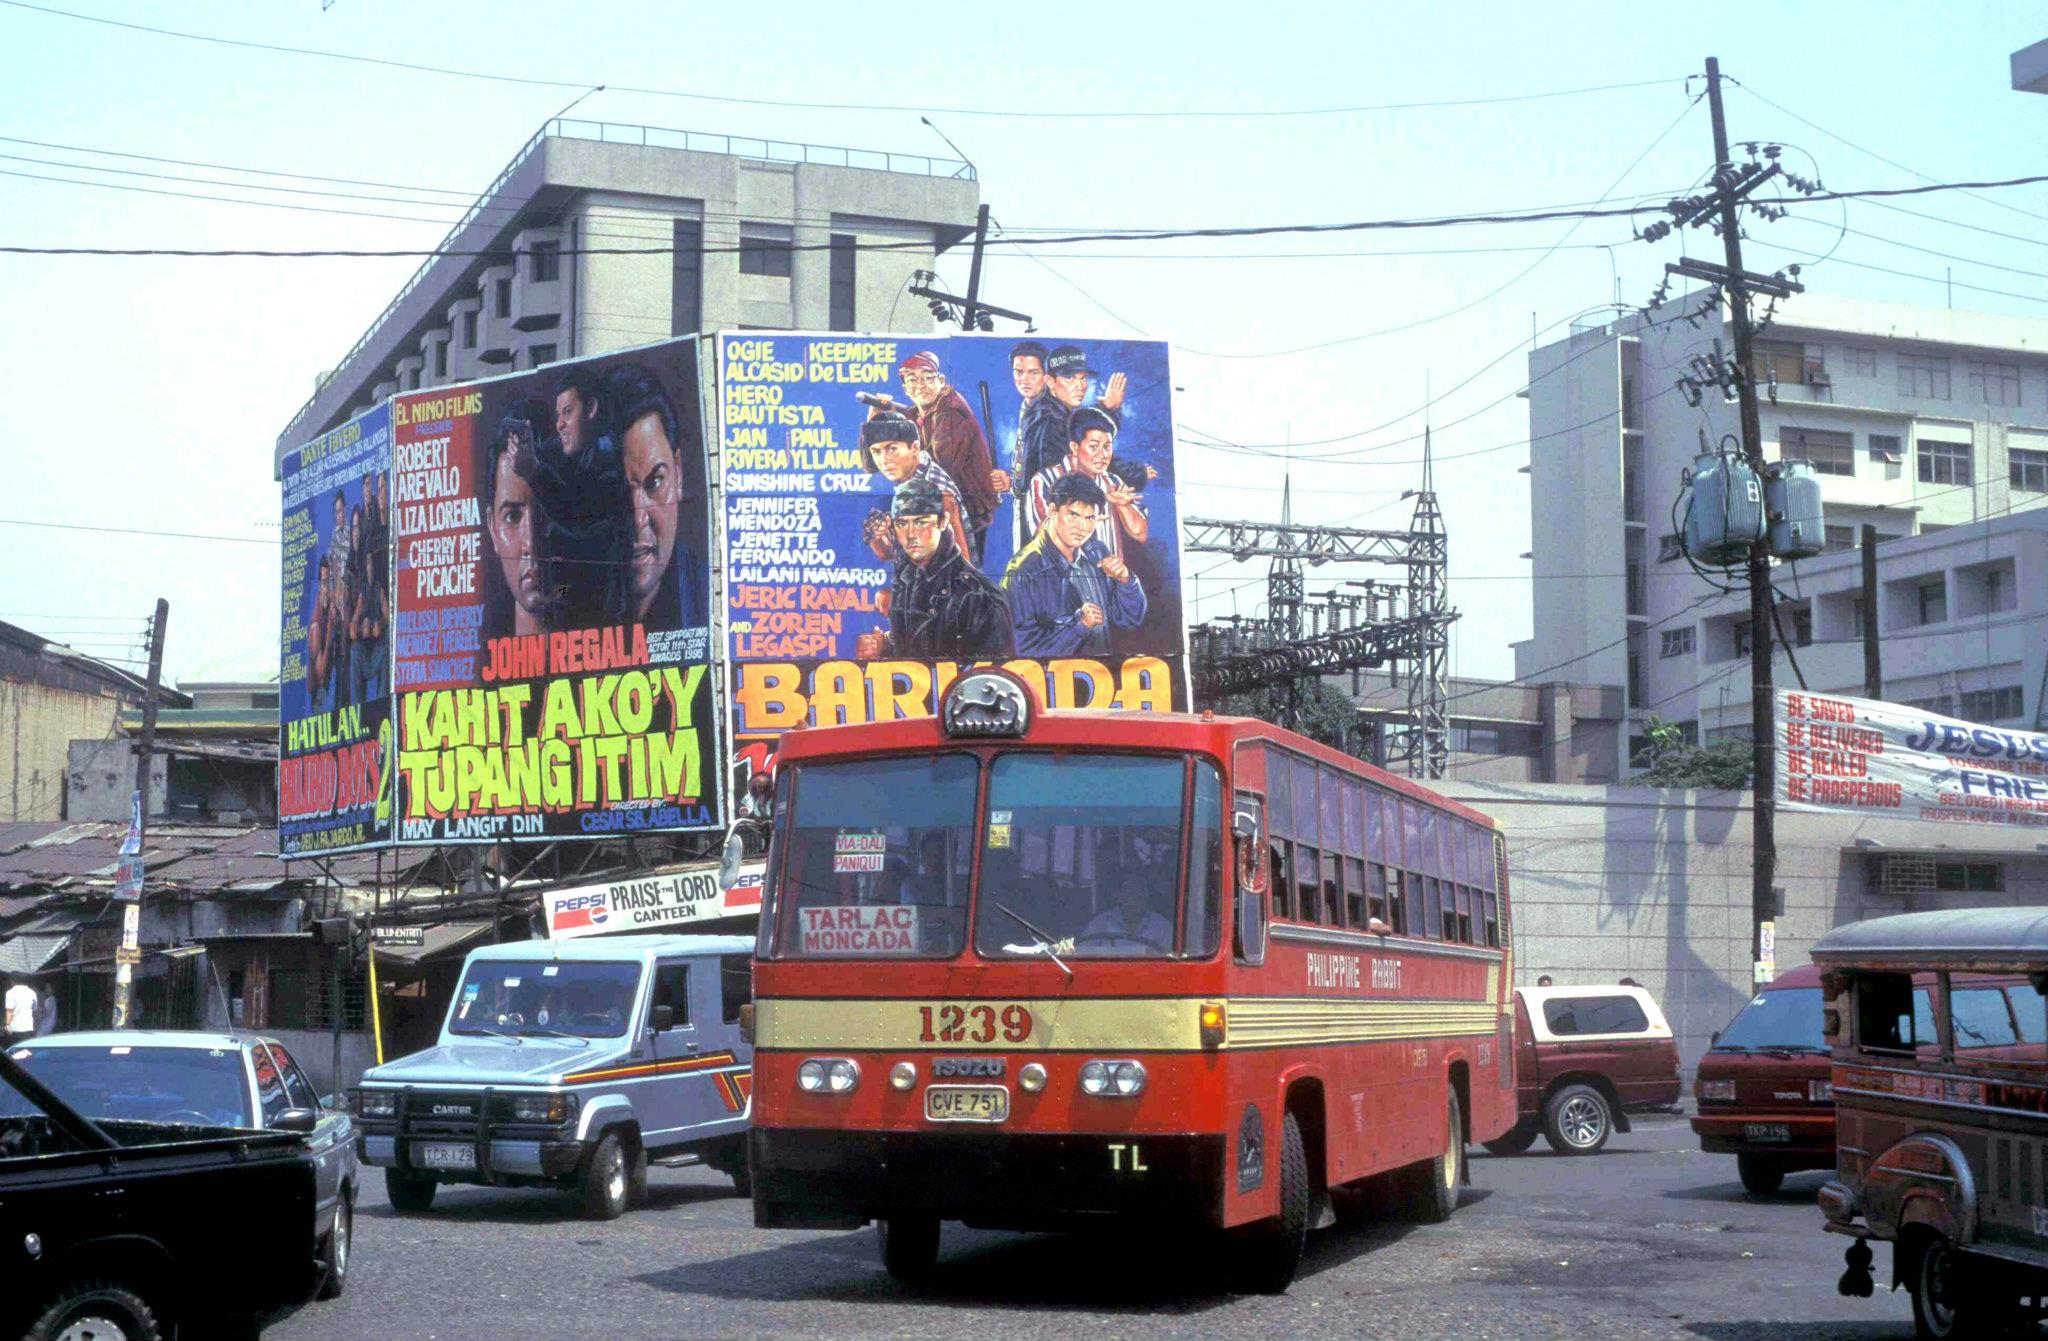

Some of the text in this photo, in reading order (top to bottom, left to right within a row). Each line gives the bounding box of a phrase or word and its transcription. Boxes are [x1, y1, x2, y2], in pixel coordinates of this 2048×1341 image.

[726, 341, 775, 362] OGIE
[809, 342, 898, 364] KEEMPEE
[726, 362, 804, 383] ALCASID
[810, 364, 889, 384] De LEON
[726, 384, 783, 406] HERO
[396, 392, 482, 426] EL NINO FILMS
[726, 404, 826, 426] BAUTISTA
[726, 428, 768, 448] JAN
[790, 428, 838, 448] PAUL
[396, 437, 450, 473] ROBERT
[726, 449, 788, 470] RIVERA
[790, 449, 863, 470] YLLANA
[398, 466, 460, 502] AREVALO
[726, 473, 873, 492] SUNSHINE CRUZ
[398, 497, 481, 536] LIZA LORENA
[728, 497, 819, 514] JENNIFER
[729, 514, 822, 532] MENDOZA
[410, 532, 481, 568] CHERRY PIE
[731, 532, 818, 550] JENETTE
[730, 549, 836, 566] FERNANDO
[417, 563, 476, 598] PICACHE
[730, 566, 887, 587] LAILANI NAVARRO
[730, 584, 875, 612] JERIC RAVAL
[730, 612, 842, 634] AND ZOREN
[646, 632, 664, 644] BEST
[648, 641, 670, 653] ACTOR
[687, 637, 706, 650] STAR
[736, 634, 837, 658] LEGASPI
[482, 623, 650, 682] JOHN REGALA
[650, 650, 682, 663] AWARDS
[404, 665, 708, 751] KAHIT AKO'Y
[1787, 694, 1855, 724] BE SAVED
[1787, 722, 1884, 754] BE DELIVERED
[375, 718, 392, 829] 2
[400, 738, 572, 817] TUPANG
[582, 728, 701, 803] ITIM
[1788, 749, 1867, 778] BE HEALED
[1788, 777, 1902, 808] BE PROSPEROUS
[610, 800, 651, 810] DIRECTED
[402, 814, 544, 839] MAY LANGIT DIN
[581, 812, 625, 832] CESAR
[648, 805, 712, 828] ABELLA
[834, 856, 881, 871] PANIQUI
[554, 894, 606, 912] PEPSI
[610, 882, 663, 911] PRAISE
[662, 886, 674, 894] THE
[674, 874, 717, 904] LORD
[634, 905, 696, 924] CANTEEN
[804, 907, 912, 930] TARLAC
[804, 931, 912, 950] MONCADA
[1308, 953, 1360, 988] PHILIPPINE
[920, 1004, 1032, 1042] 1239
[432, 1105, 472, 1114] CARTER
[933, 1094, 998, 1111] CVE 751
